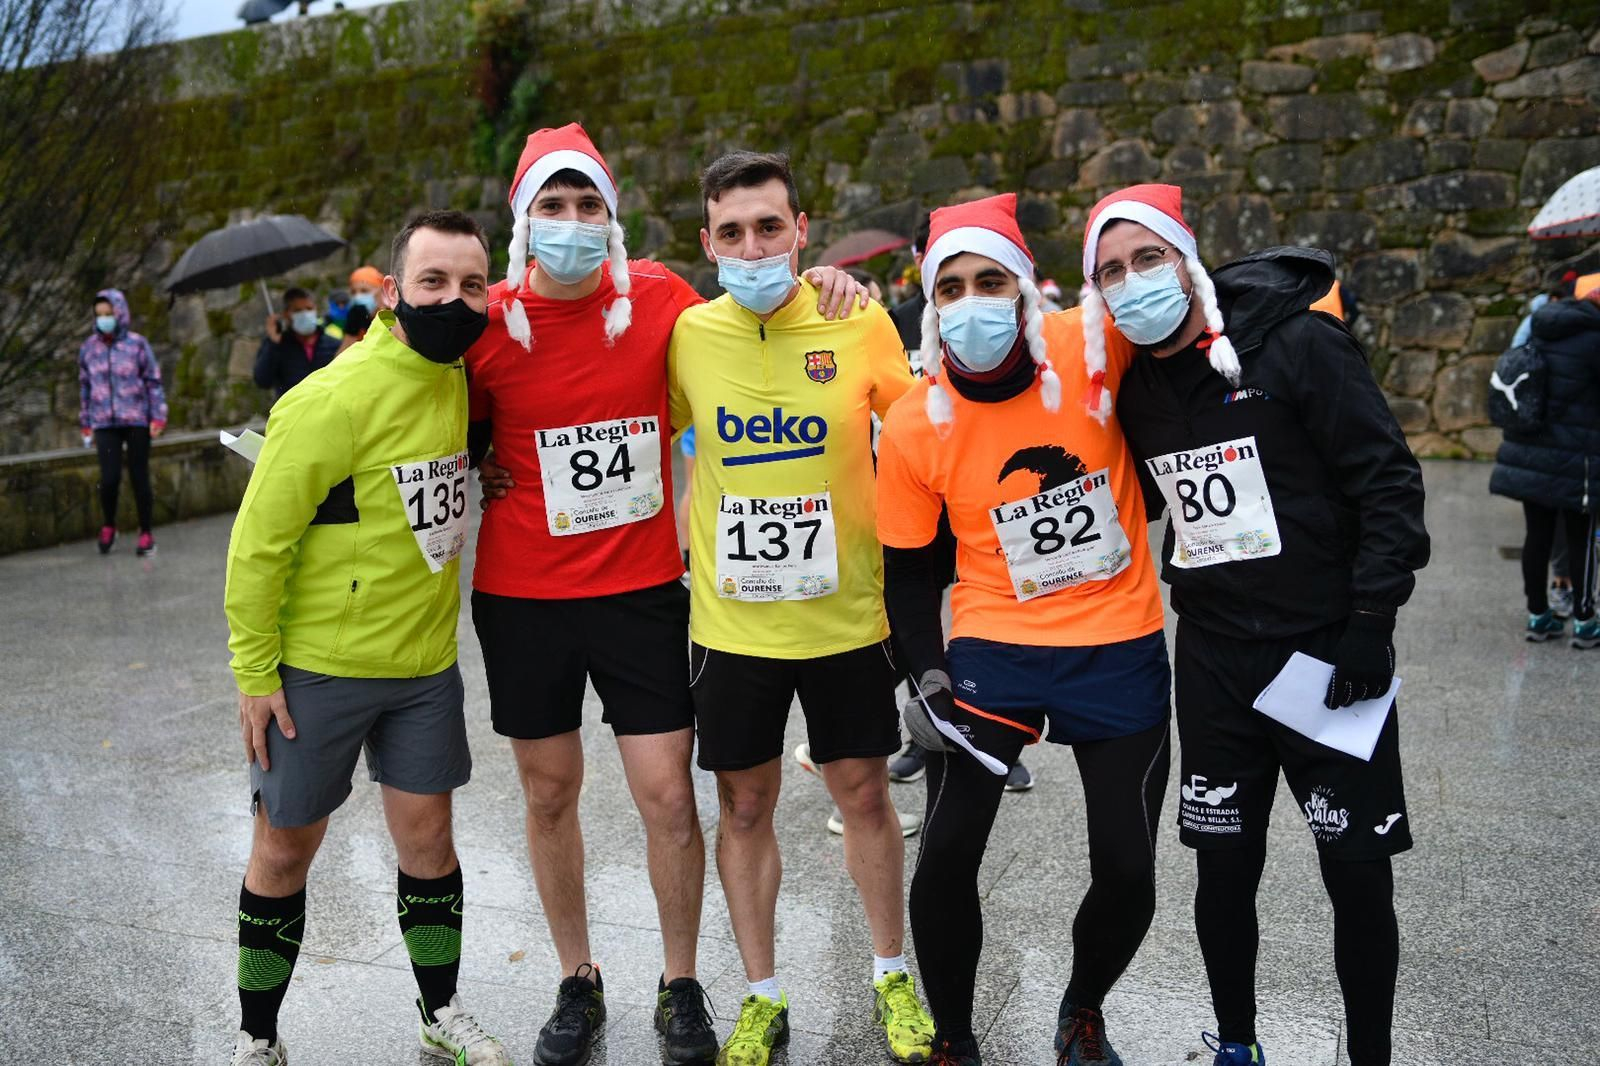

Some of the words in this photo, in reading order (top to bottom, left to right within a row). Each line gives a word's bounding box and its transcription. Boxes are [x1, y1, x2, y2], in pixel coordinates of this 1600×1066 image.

[717, 406, 827, 444] beko
[539, 431, 571, 448] La
[395, 466, 424, 484] La
[569, 443, 635, 491] 84
[1147, 459, 1174, 477] La
[408, 477, 465, 532] 135
[720, 495, 744, 515] La
[1175, 473, 1236, 523] 80
[574, 510, 616, 524] OURENSE
[993, 506, 1028, 524] La
[1030, 505, 1102, 555] 82
[727, 519, 822, 561] 137
[1186, 545, 1225, 557] OURENSE
[741, 584, 783, 593] OURENSE
[1041, 571, 1084, 587] OURENSE
[1305, 801, 1350, 829] Salas
